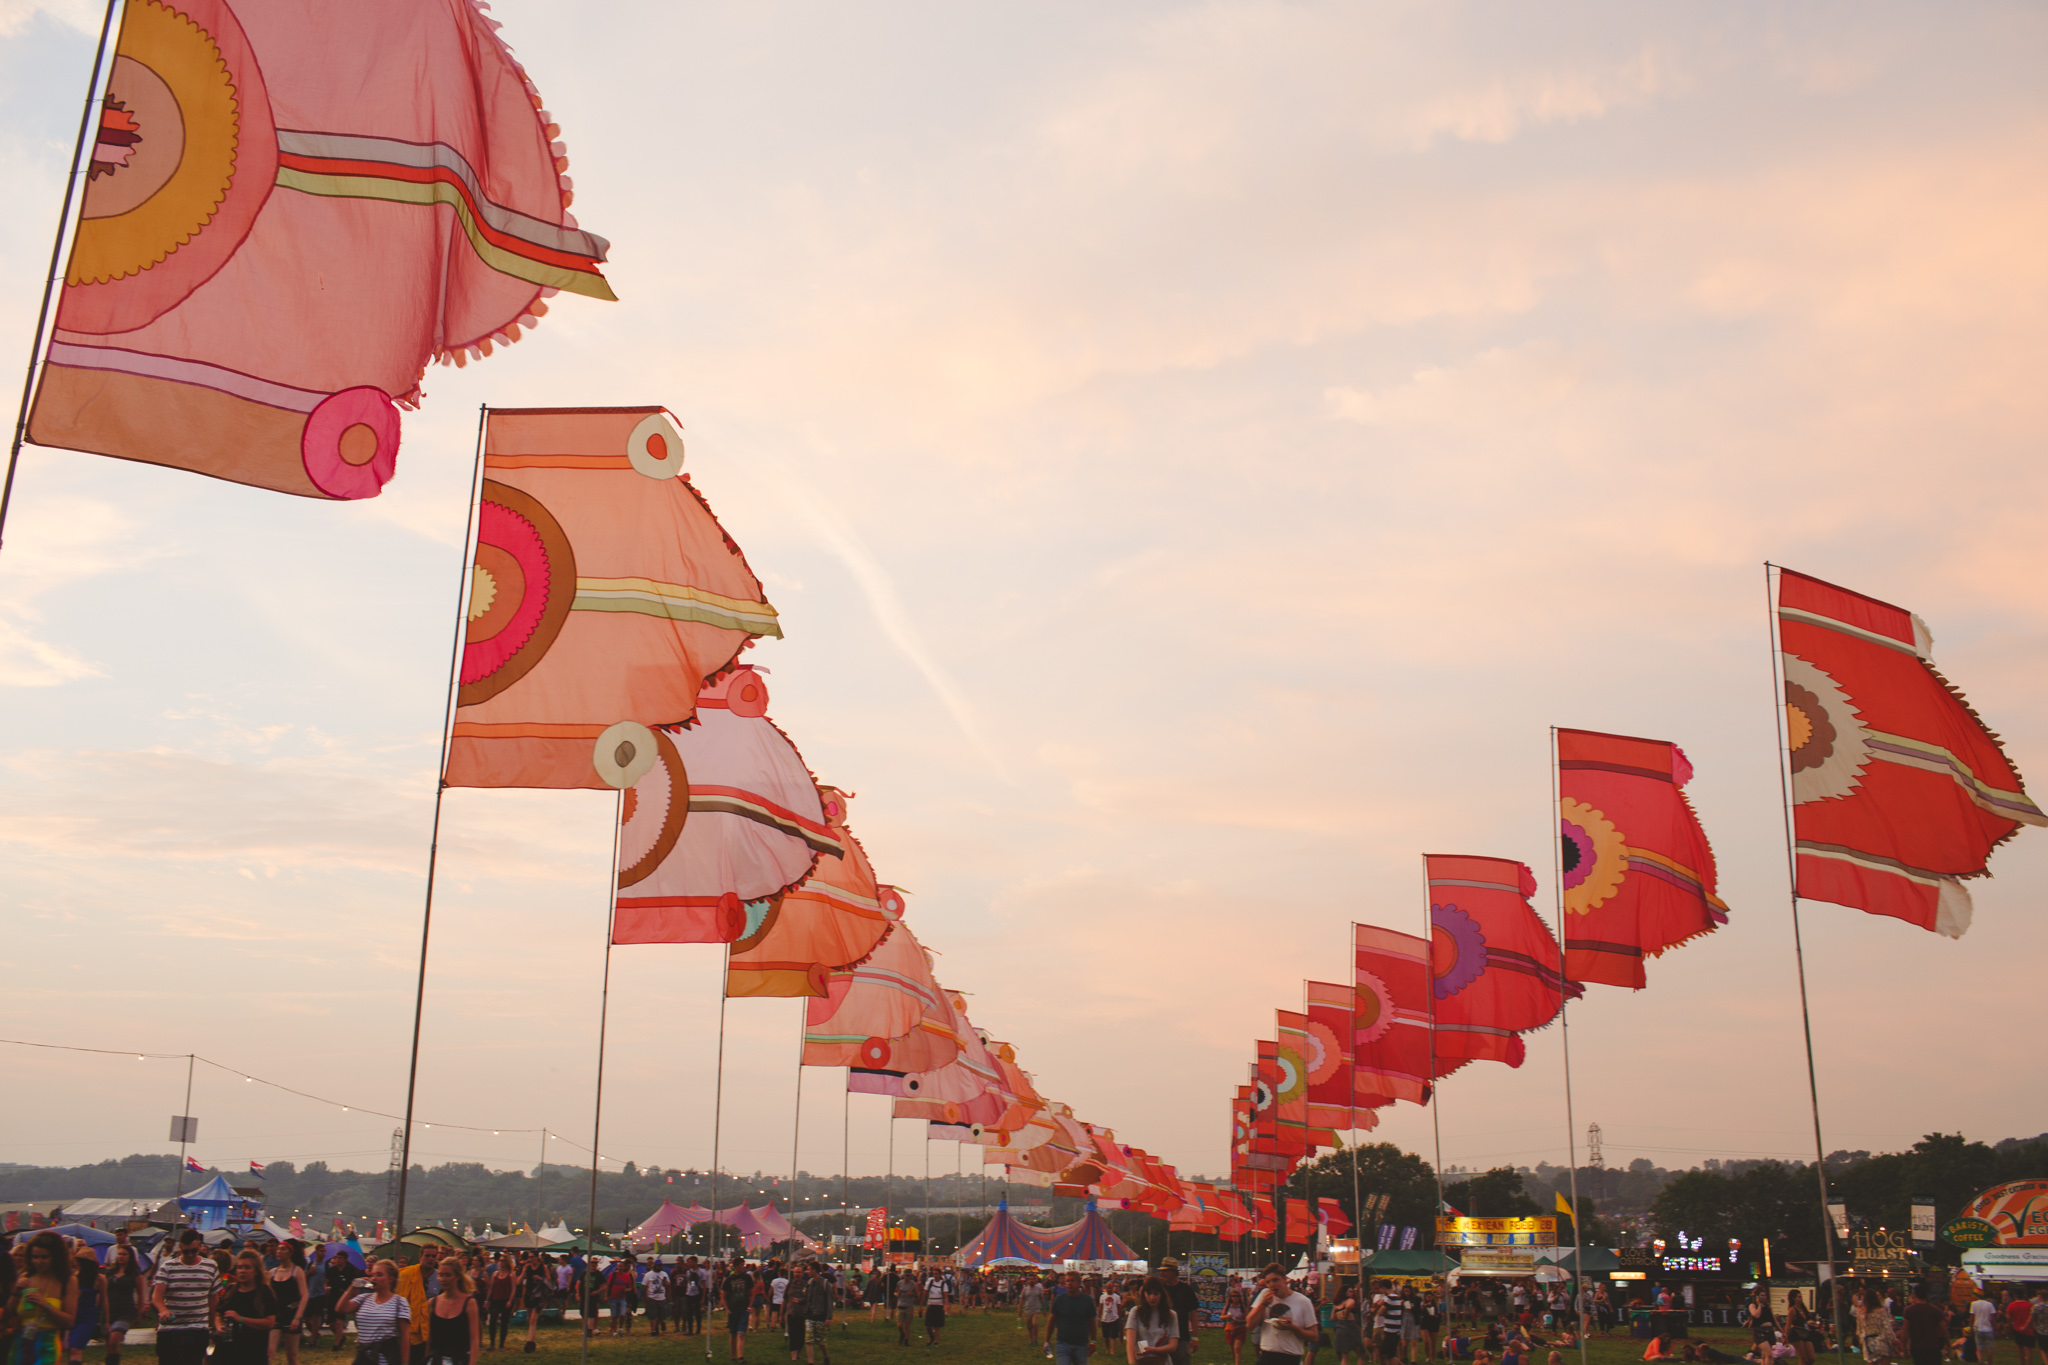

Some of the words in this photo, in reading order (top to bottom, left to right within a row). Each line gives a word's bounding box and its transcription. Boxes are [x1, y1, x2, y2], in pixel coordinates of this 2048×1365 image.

[1852, 1230, 1906, 1248] HOG
[1953, 1233, 1985, 1242] COFFEE
[1854, 1247, 1908, 1260] ROAST
[1984, 1252, 2021, 1260] Goodness
